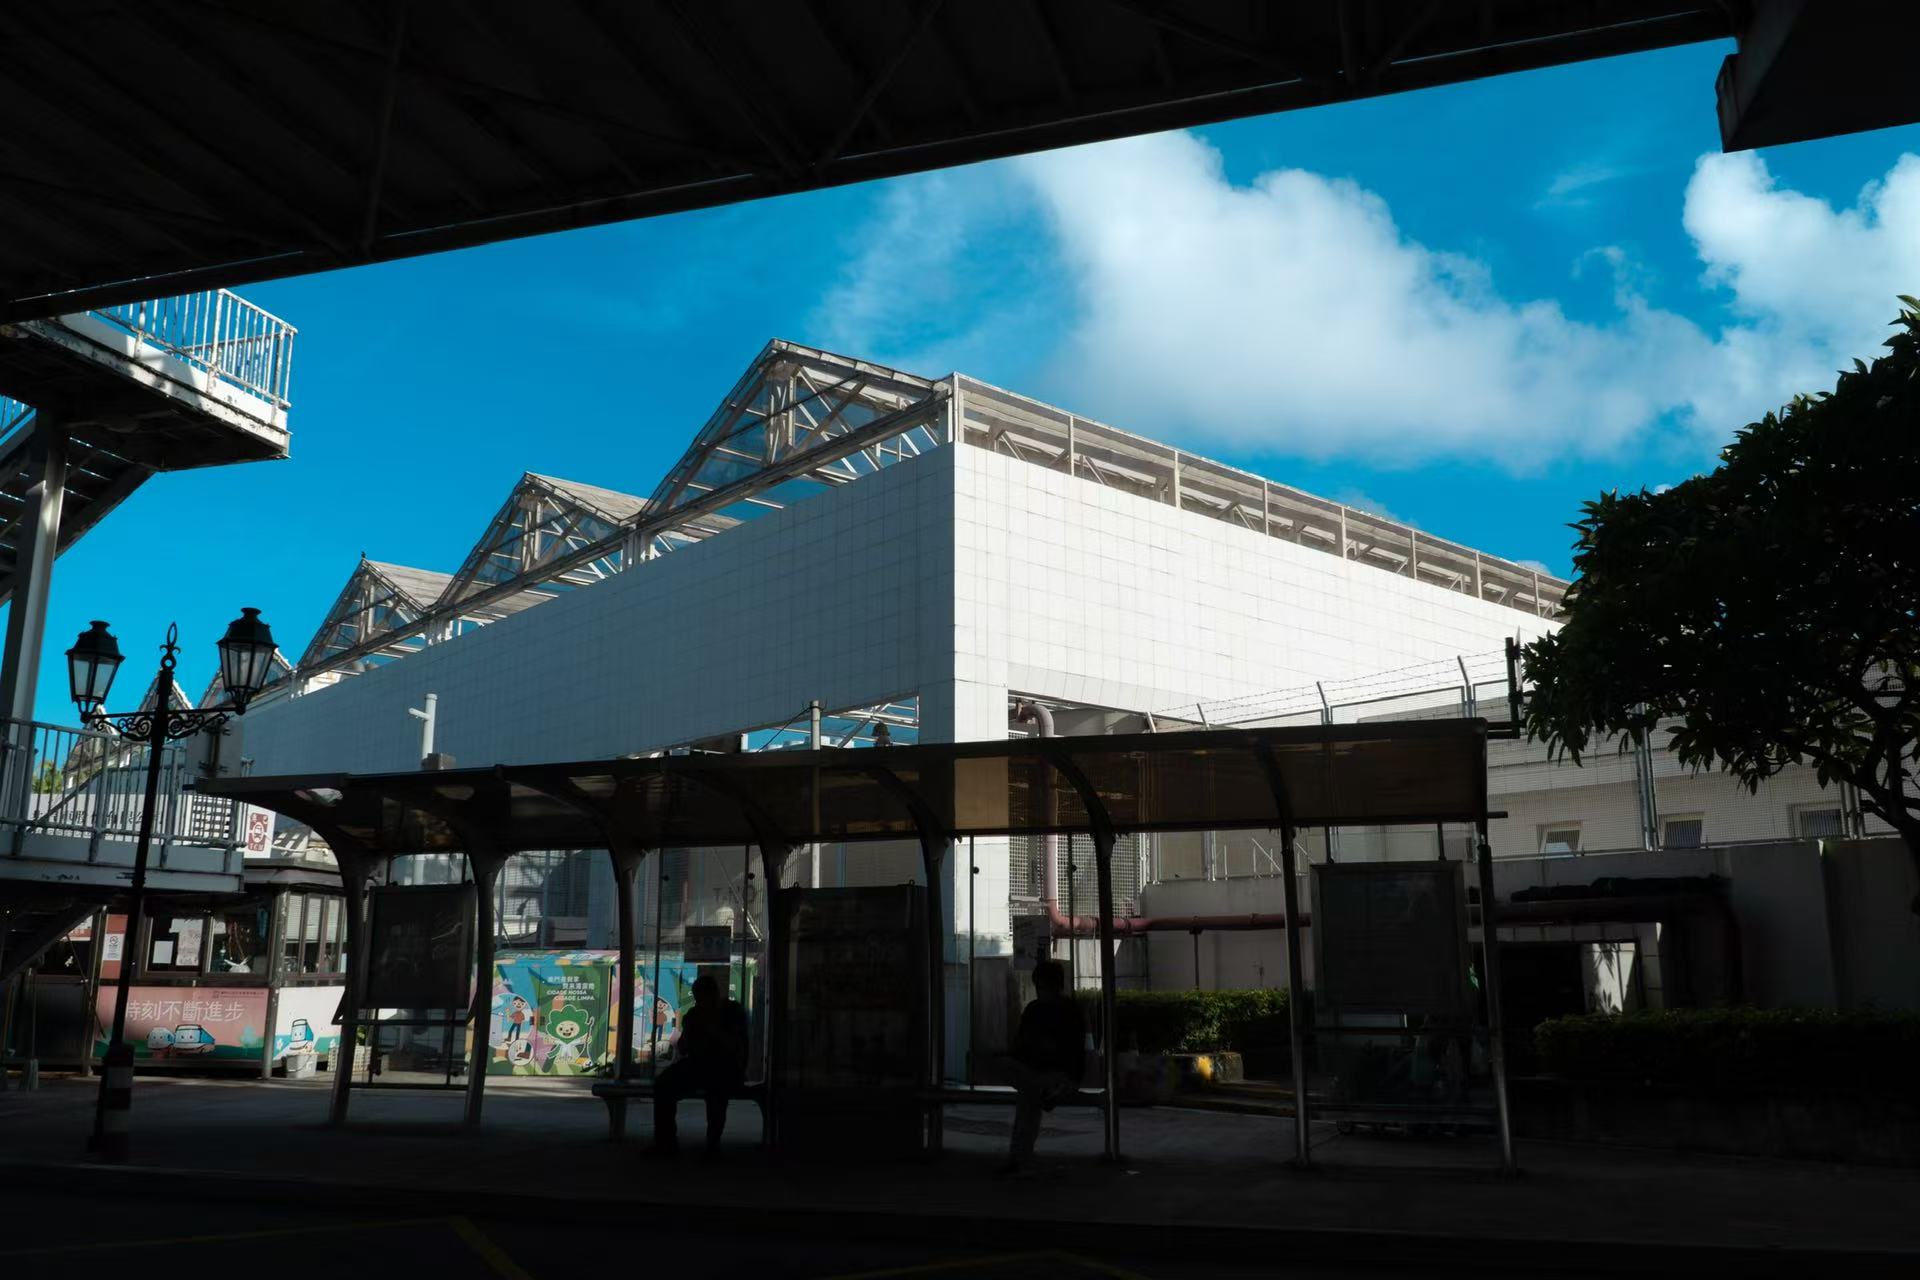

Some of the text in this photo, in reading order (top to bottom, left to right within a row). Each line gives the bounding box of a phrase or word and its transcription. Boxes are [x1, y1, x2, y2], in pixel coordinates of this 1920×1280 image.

[125, 1000, 244, 1023] 時刻不斷進步
